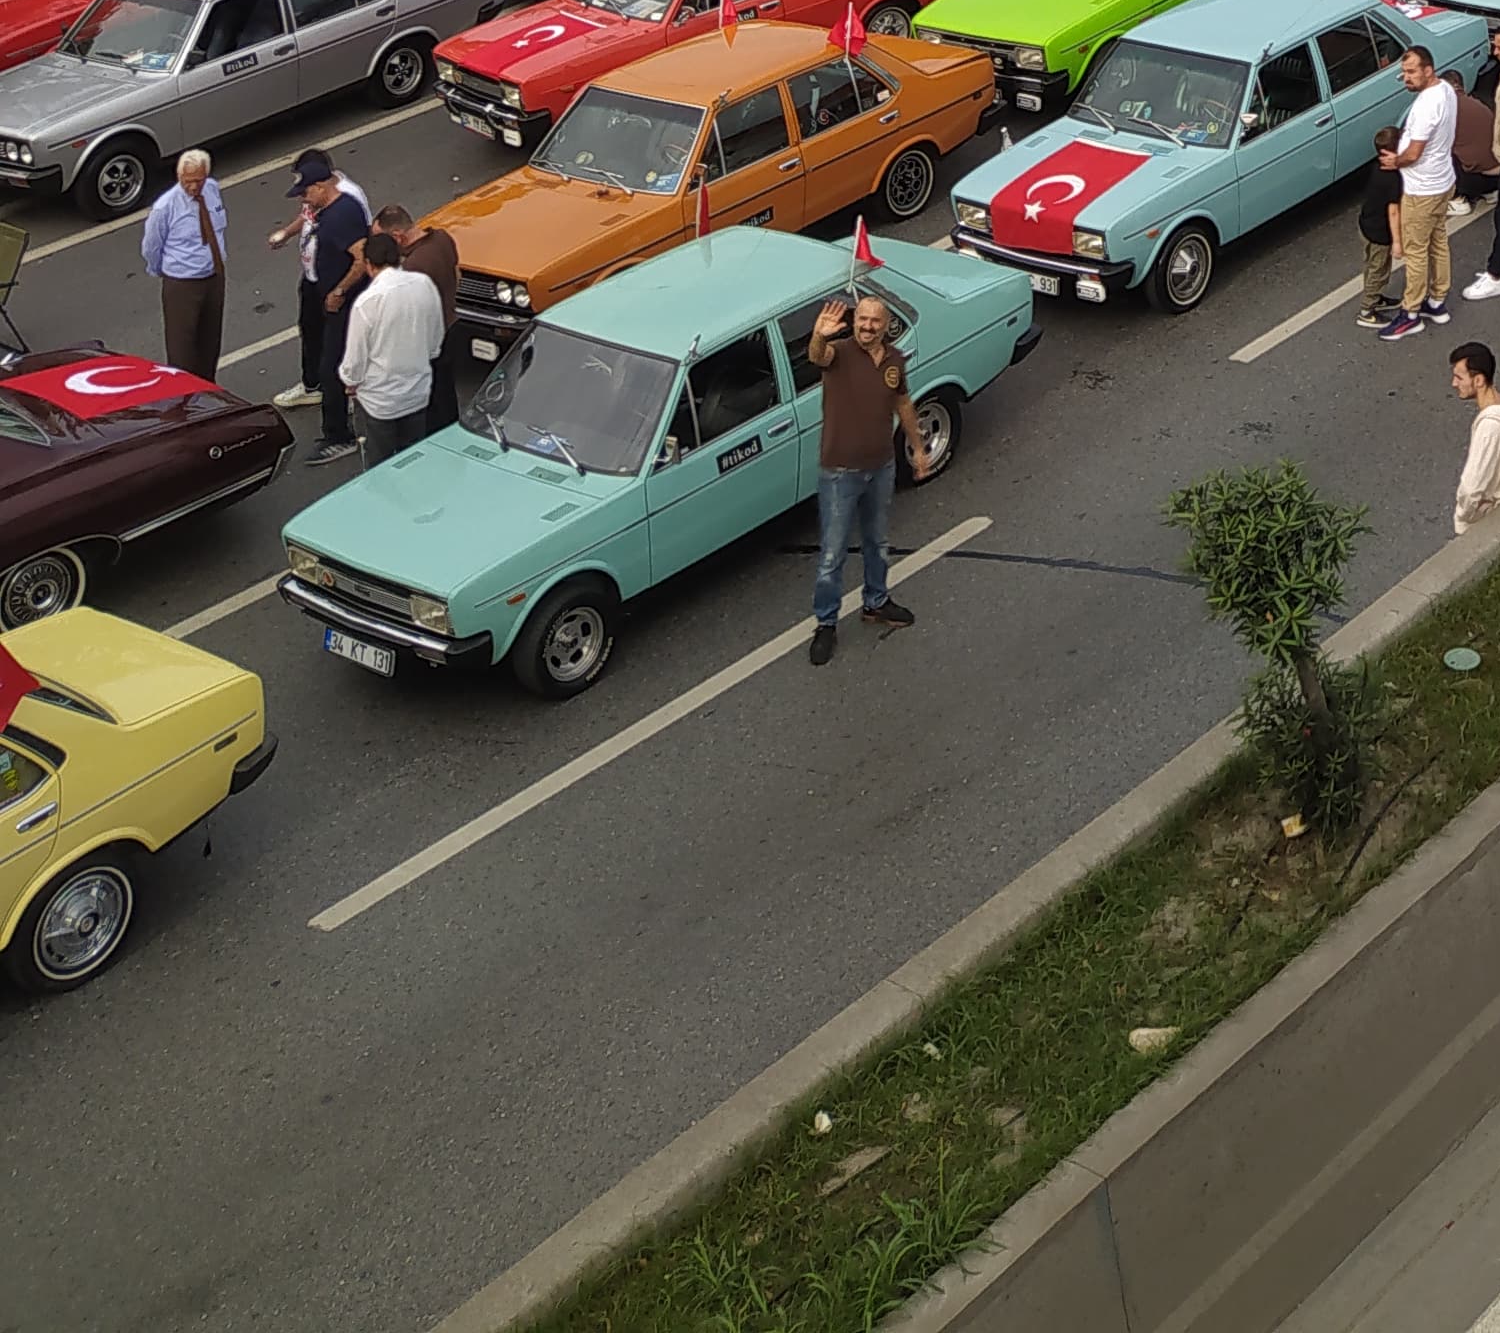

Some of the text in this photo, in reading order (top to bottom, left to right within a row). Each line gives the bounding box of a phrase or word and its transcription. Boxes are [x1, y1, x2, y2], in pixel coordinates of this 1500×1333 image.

[1040, 277, 1056, 294] 931
[721, 439, 759, 470] #tikod
[331, 633, 389, 672] 34 KT 131
